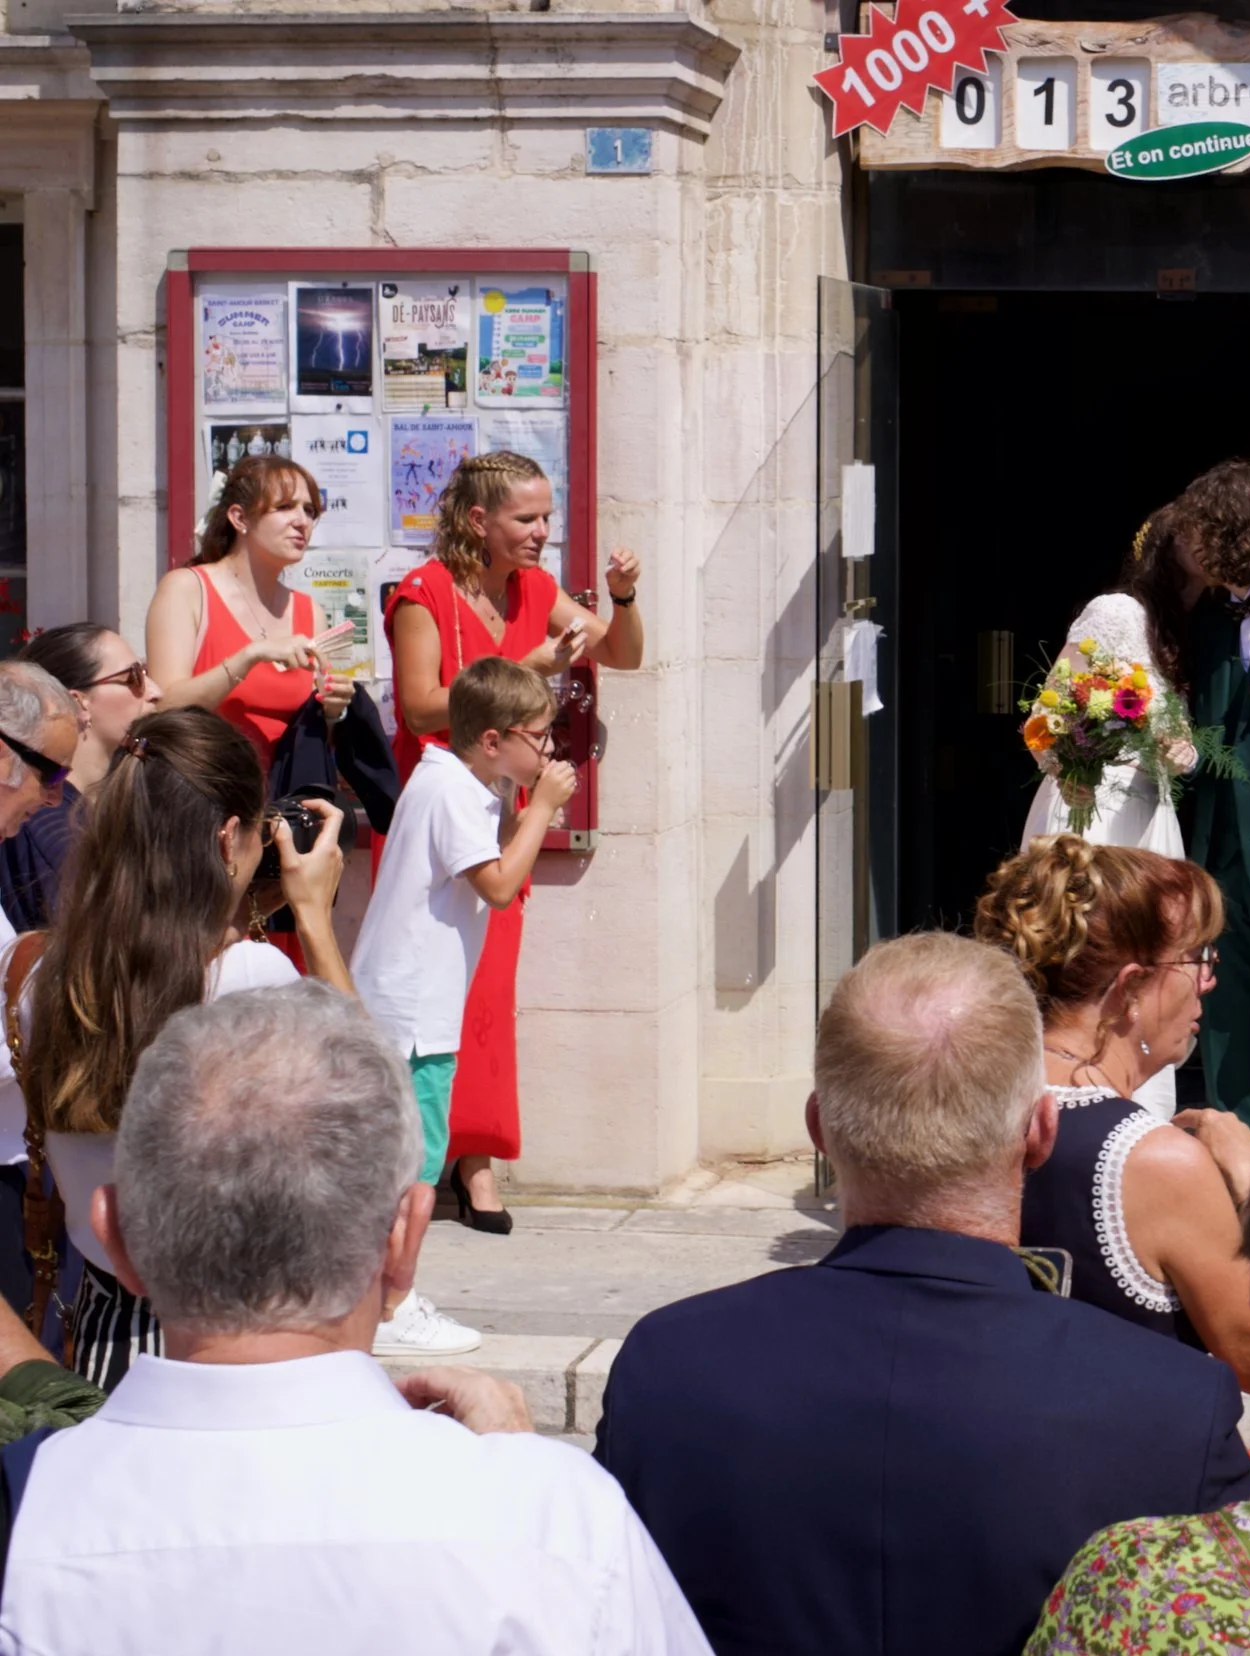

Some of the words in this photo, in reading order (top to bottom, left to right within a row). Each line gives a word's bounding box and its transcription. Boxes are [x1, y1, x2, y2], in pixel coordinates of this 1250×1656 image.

[841, 10, 957, 107] 1000
[1105, 78, 1137, 128] 3
[613, 138, 623, 163] 1
[1111, 150, 1134, 170] Et
[1138, 146, 1164, 165] on
[217, 310, 271, 328] SUMMER
[232, 320, 256, 328] CAMP
[394, 423, 409, 431] BAL
[411, 423, 420, 431] DE
[303, 567, 354, 578] Concerts
